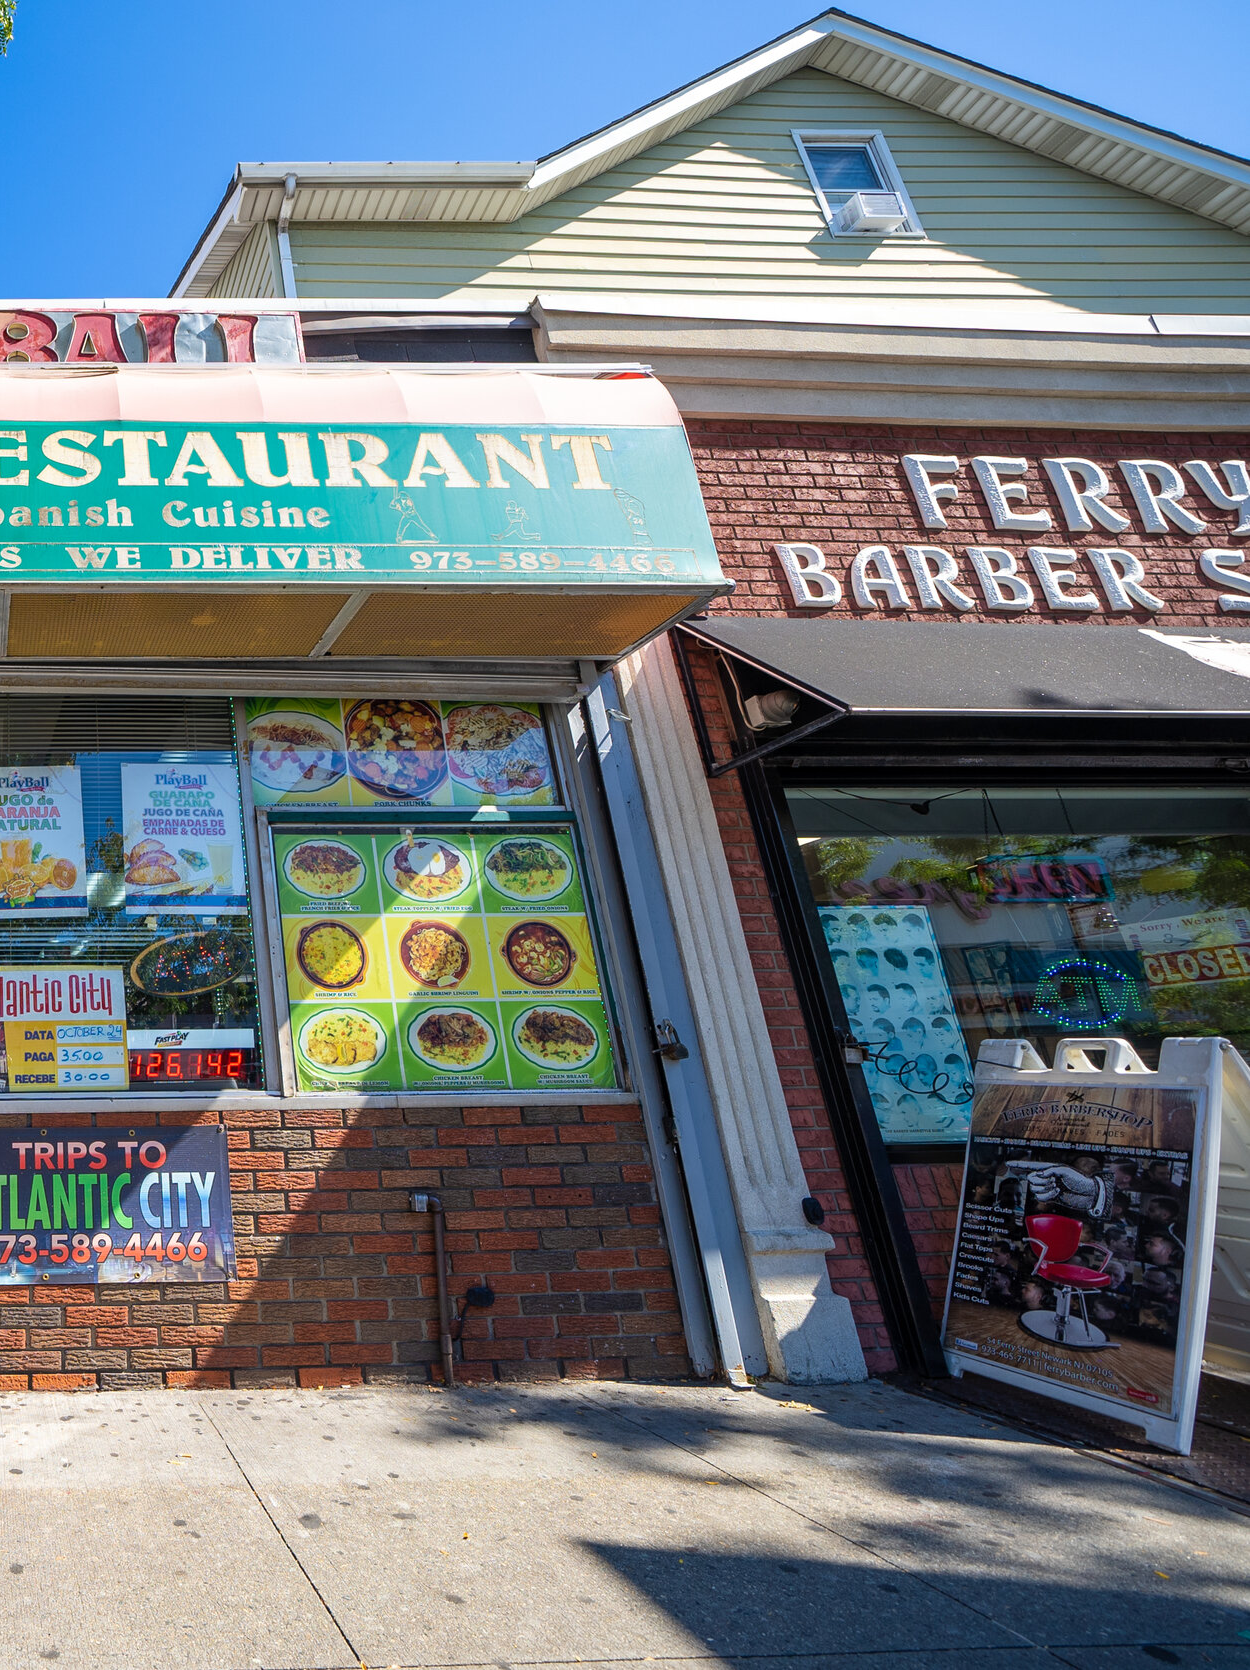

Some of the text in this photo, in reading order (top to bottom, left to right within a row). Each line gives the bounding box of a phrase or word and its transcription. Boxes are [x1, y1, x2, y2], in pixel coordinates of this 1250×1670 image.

[901, 453, 1250, 537] FERRY
[161, 500, 331, 529] Cuisine
[65, 546, 142, 570] WE
[170, 546, 366, 571] DELIVER
[409, 550, 676, 575] 973-589-4466
[773, 543, 1166, 613] BARBER
[154, 774, 207, 788] PlayBall
[36, 795, 55, 806] de
[148, 790, 216, 799] GUARAPO
[153, 799, 171, 807] DE
[142, 808, 173, 817] JUGO
[175, 808, 190, 817] DE
[143, 818, 225, 827] EMPANADAS DE
[144, 827, 178, 836] CARNE
[190, 827, 226, 837] QUESO
[68, 972, 113, 1016] City
[1032, 975, 1142, 1012] ATM
[24, 1029, 54, 1041] DATA
[57, 1024, 123, 1041] OCTOBER 24
[24, 1051, 55, 1062] PAGA
[14, 1073, 56, 1084] RECEBE
[1002, 1105, 1048, 1123] FERRY
[1051, 1103, 1154, 1130] BARBERSHOP
[11, 1140, 167, 1170] TRIPS TO
[139, 1171, 216, 1229] CITY
[965, 1202, 1013, 1214] Scissor Cuts
[964, 1212, 1005, 1224] Shape Ups
[962, 1222, 1009, 1234] Beard Trims
[961, 1231, 992, 1242] Caesars
[960, 1241, 994, 1253] Flat Tops
[956, 1271, 979, 1281] Fades
[954, 1281, 982, 1293] Shaves
[953, 1291, 990, 1305] Kids Cuts
[996, 1338, 1017, 1350] Ferry
[1017, 1344, 1040, 1358] Street
[1040, 1350, 1073, 1366] Newark
[1043, 1361, 1119, 1392] ferrybarber.com
